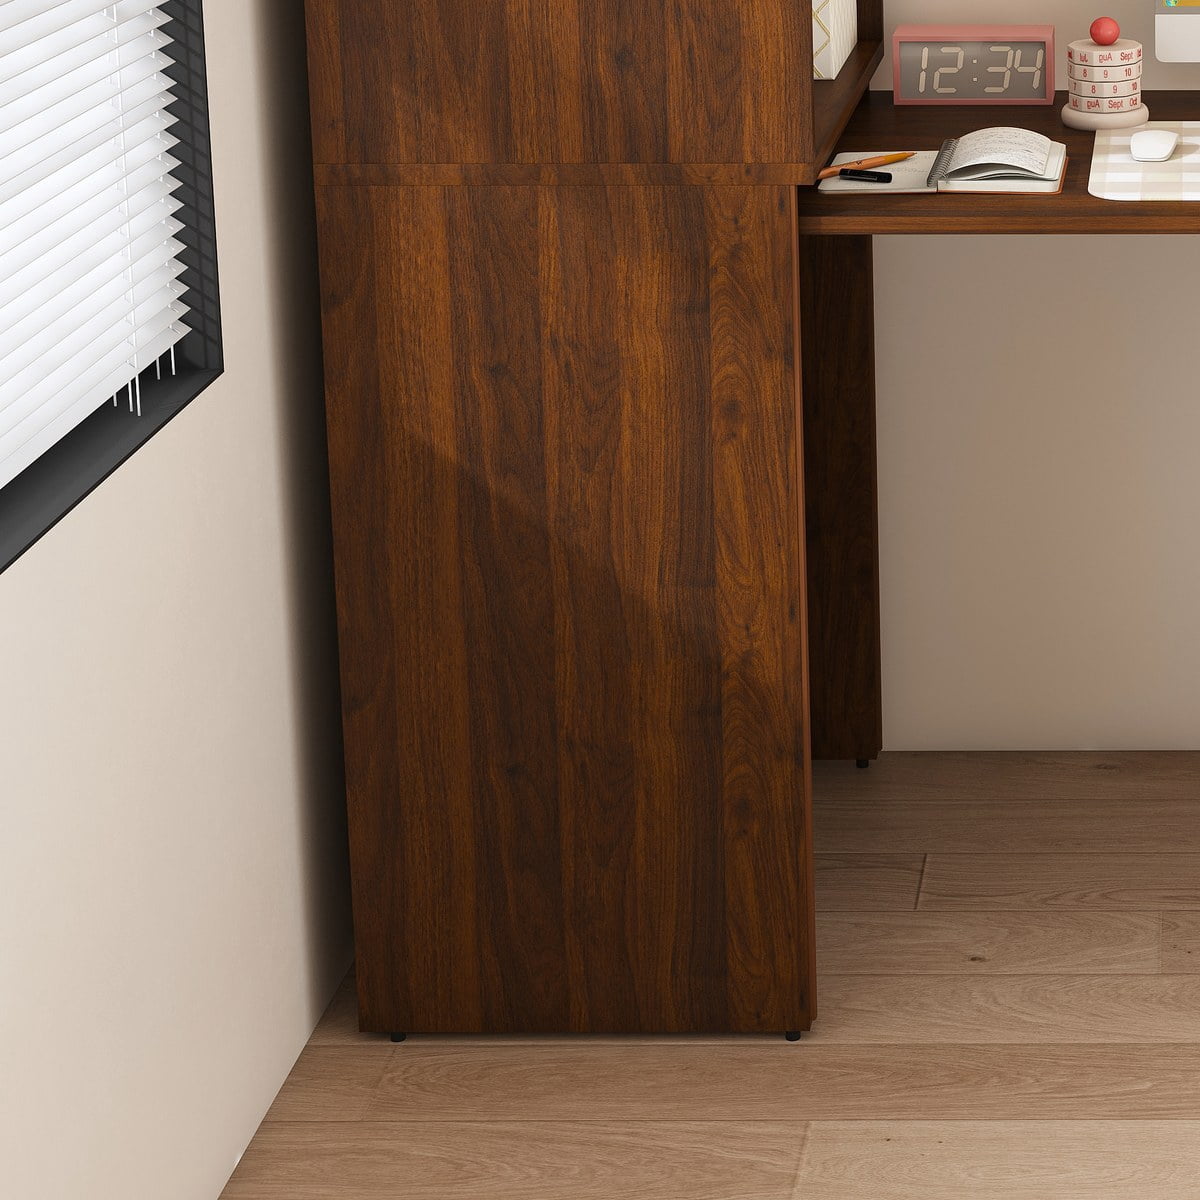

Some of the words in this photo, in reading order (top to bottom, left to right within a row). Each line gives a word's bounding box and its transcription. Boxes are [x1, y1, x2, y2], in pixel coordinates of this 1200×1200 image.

[1120, 51, 1134, 62] Sept
[919, 46, 1044, 93] 12:34
[1082, 68, 1087, 78] 8
[1103, 69, 1109, 78] 9
[1125, 67, 1132, 77] 10
[1091, 84, 1096, 94] 8
[1112, 84, 1118, 94] 9
[1131, 82, 1138, 90] 10
[1108, 99, 1124, 110] Sept
[1129, 97, 1138, 107] Oct
